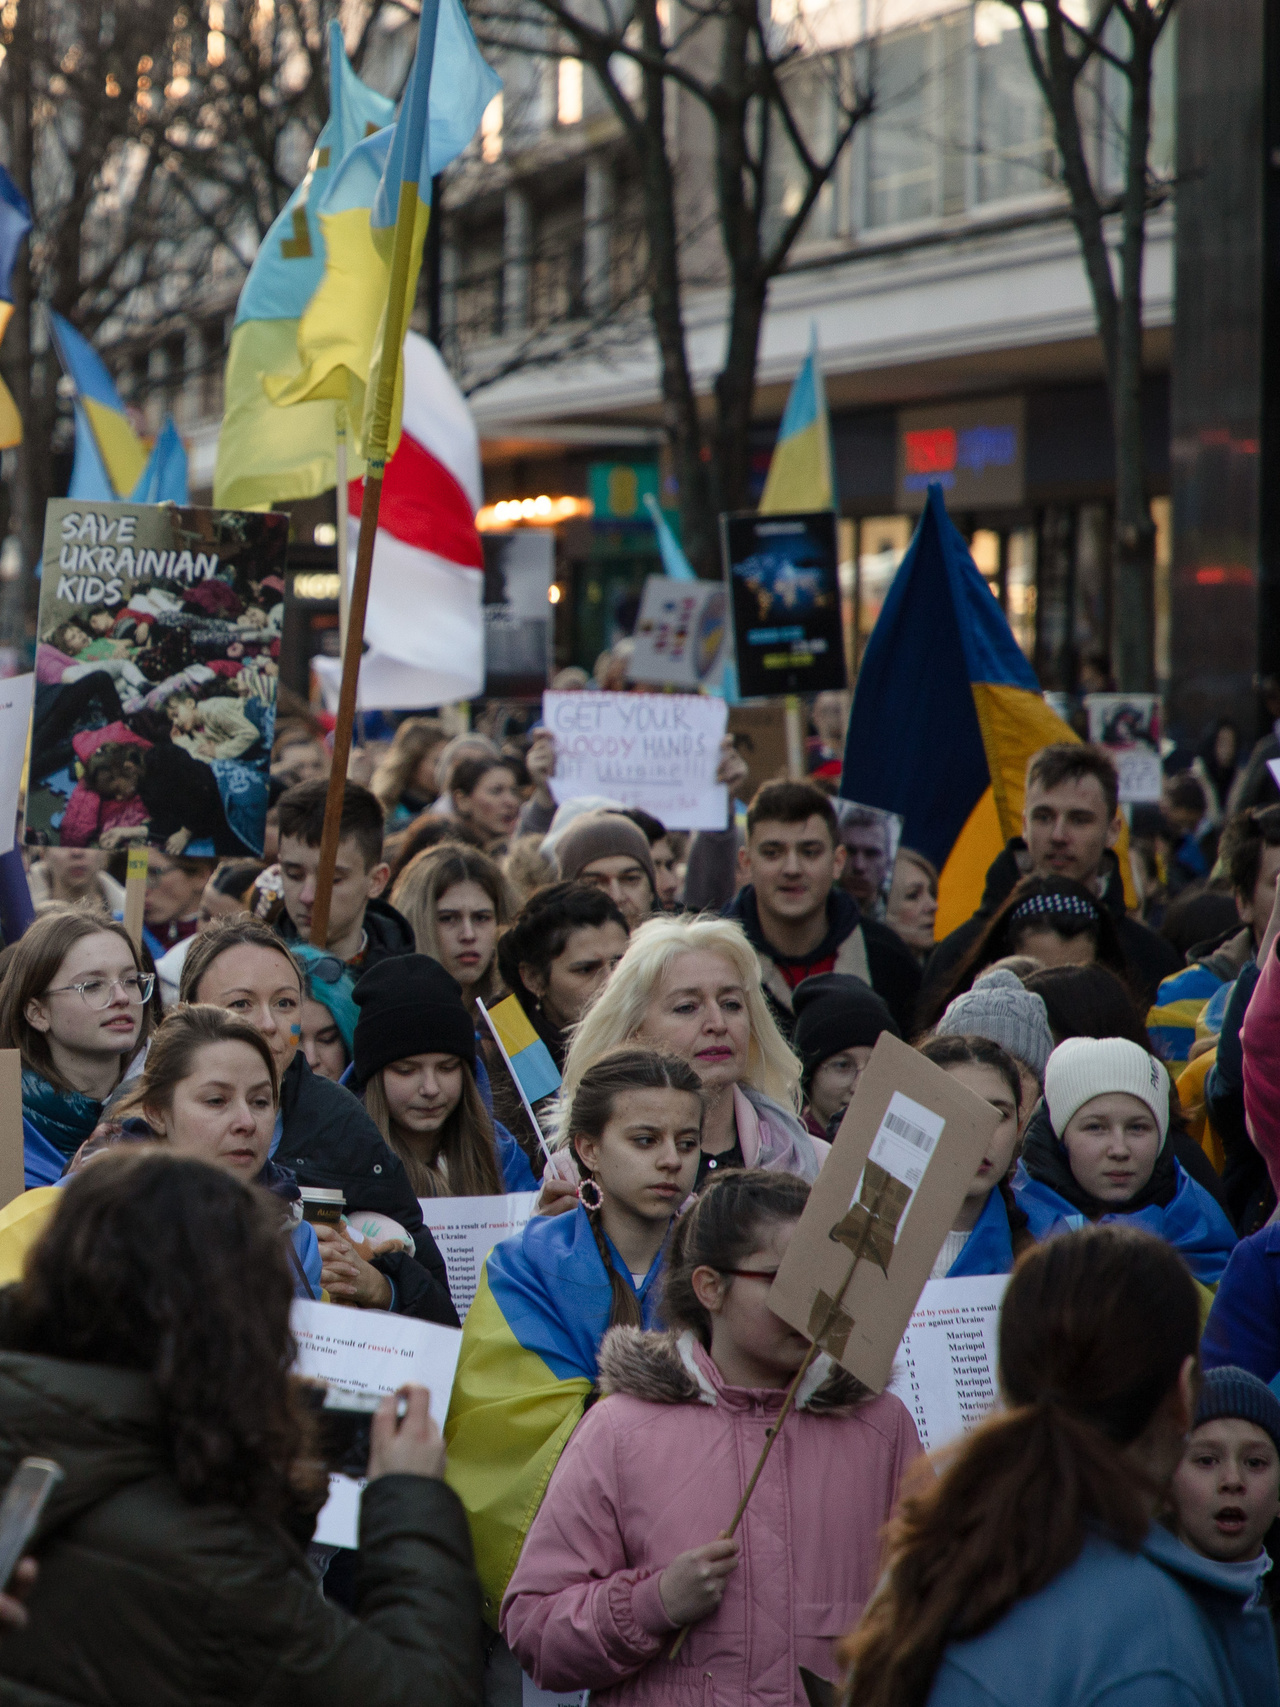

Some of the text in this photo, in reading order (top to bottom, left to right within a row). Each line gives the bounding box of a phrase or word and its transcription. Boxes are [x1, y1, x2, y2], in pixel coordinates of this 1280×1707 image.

[61, 513, 138, 544] SAVE
[60, 545, 219, 583] UKRAINIAN
[56, 574, 123, 606] KIDS
[555, 701, 692, 733] GET YOUR
[552, 733, 705, 759] LOODY HANDS
[927, 1310, 936, 1318] by
[977, 1304, 997, 1312] result
[928, 1318, 954, 1327] against
[956, 1316, 985, 1324] Ukraine
[946, 1330, 983, 1341] Mariupol
[293, 1330, 313, 1339] ussia
[333, 1338, 356, 1348] result
[358, 1341, 367, 1349] of
[368, 1343, 398, 1355] russia's
[400, 1348, 414, 1358] full
[305, 1342, 337, 1355] Ukraine
[949, 1342, 985, 1352] Mariupol
[951, 1354, 987, 1364] Mariupol
[910, 1365, 989, 1379] 8 Mariupol
[348, 1379, 368, 1388] village
[955, 1378, 992, 1387] Mariupol
[958, 1389, 994, 1399] Mariupol
[915, 1406, 924, 1414] 12
[919, 1430, 928, 1438] 14
